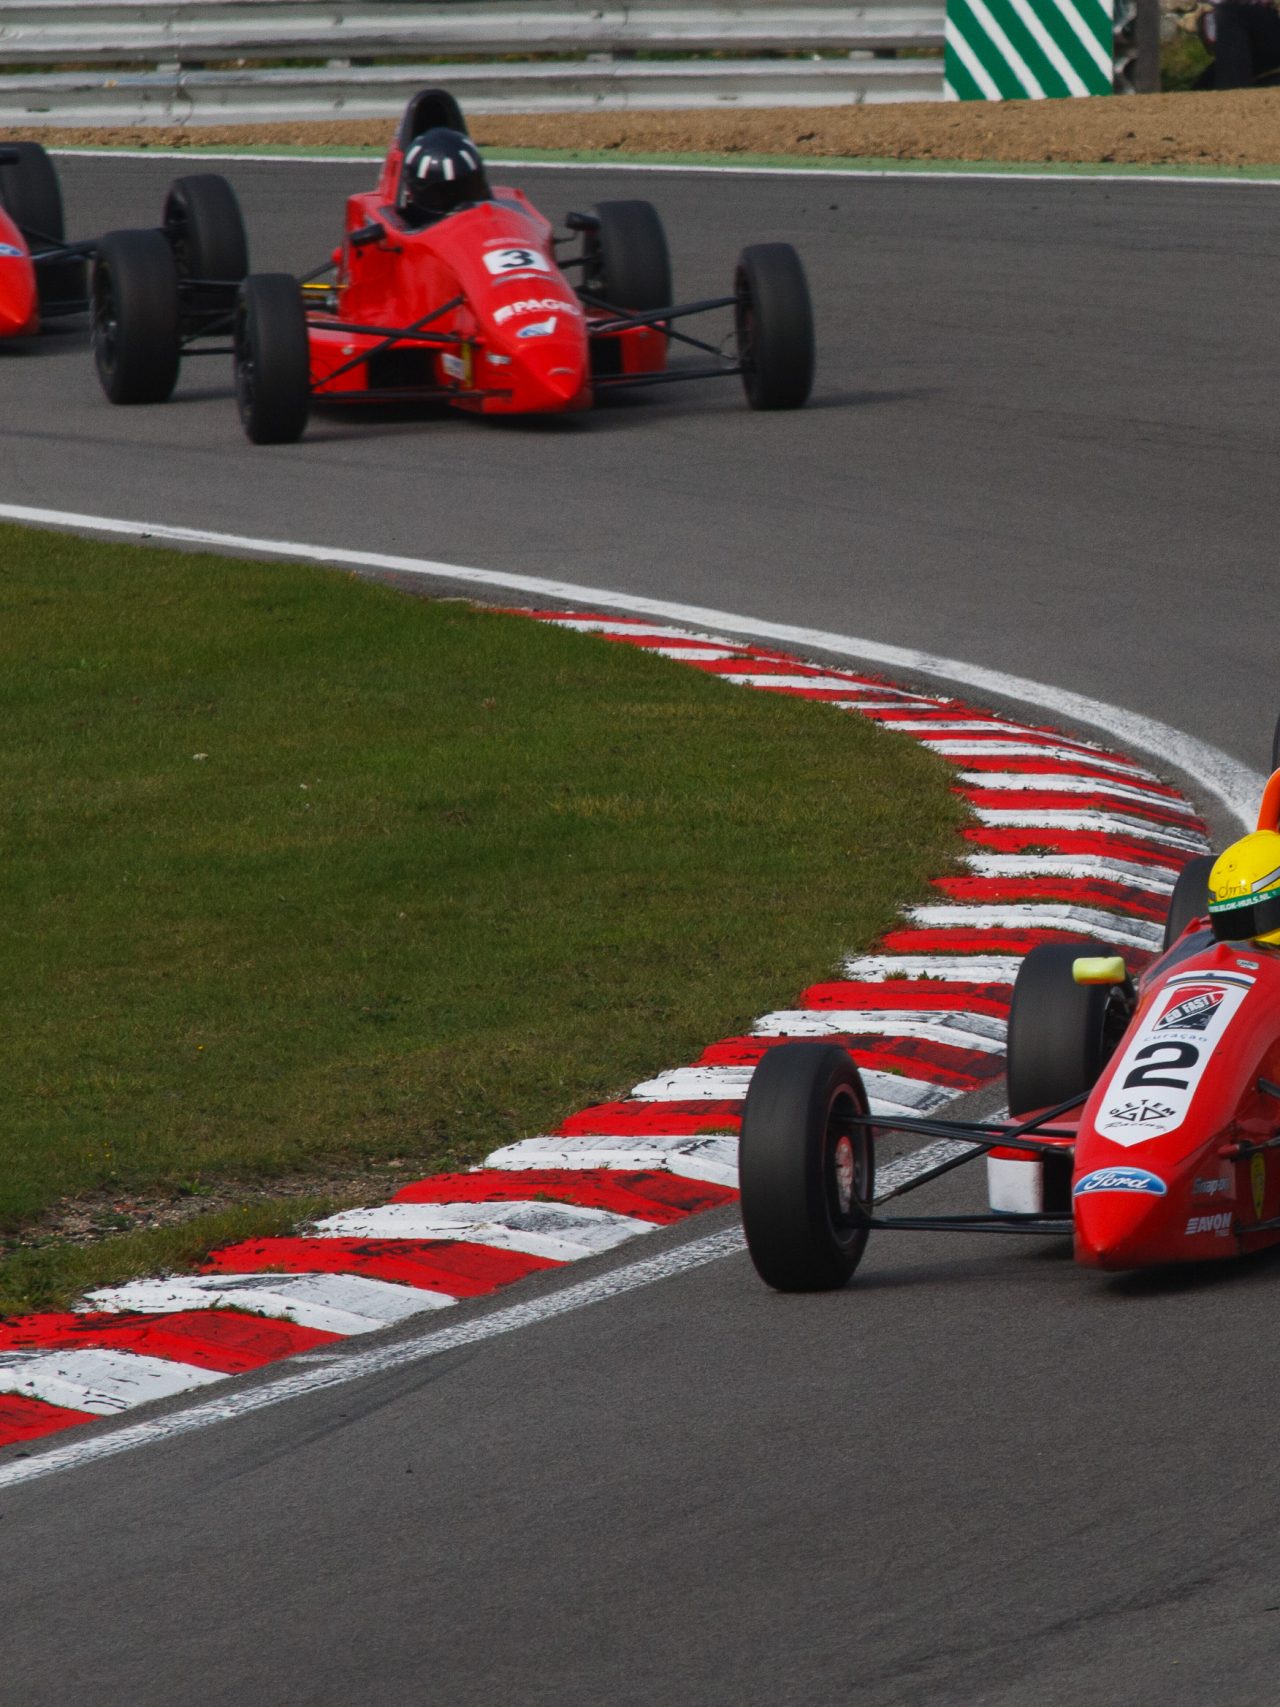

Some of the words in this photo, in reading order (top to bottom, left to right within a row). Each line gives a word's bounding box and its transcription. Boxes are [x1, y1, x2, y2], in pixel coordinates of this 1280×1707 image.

[500, 249, 534, 268] 3
[1122, 1041, 1199, 1090] 2
[1109, 1099, 1176, 1117] GETEM
[1084, 1172, 1151, 1190] Ford
[1197, 1212, 1232, 1233] AVON
